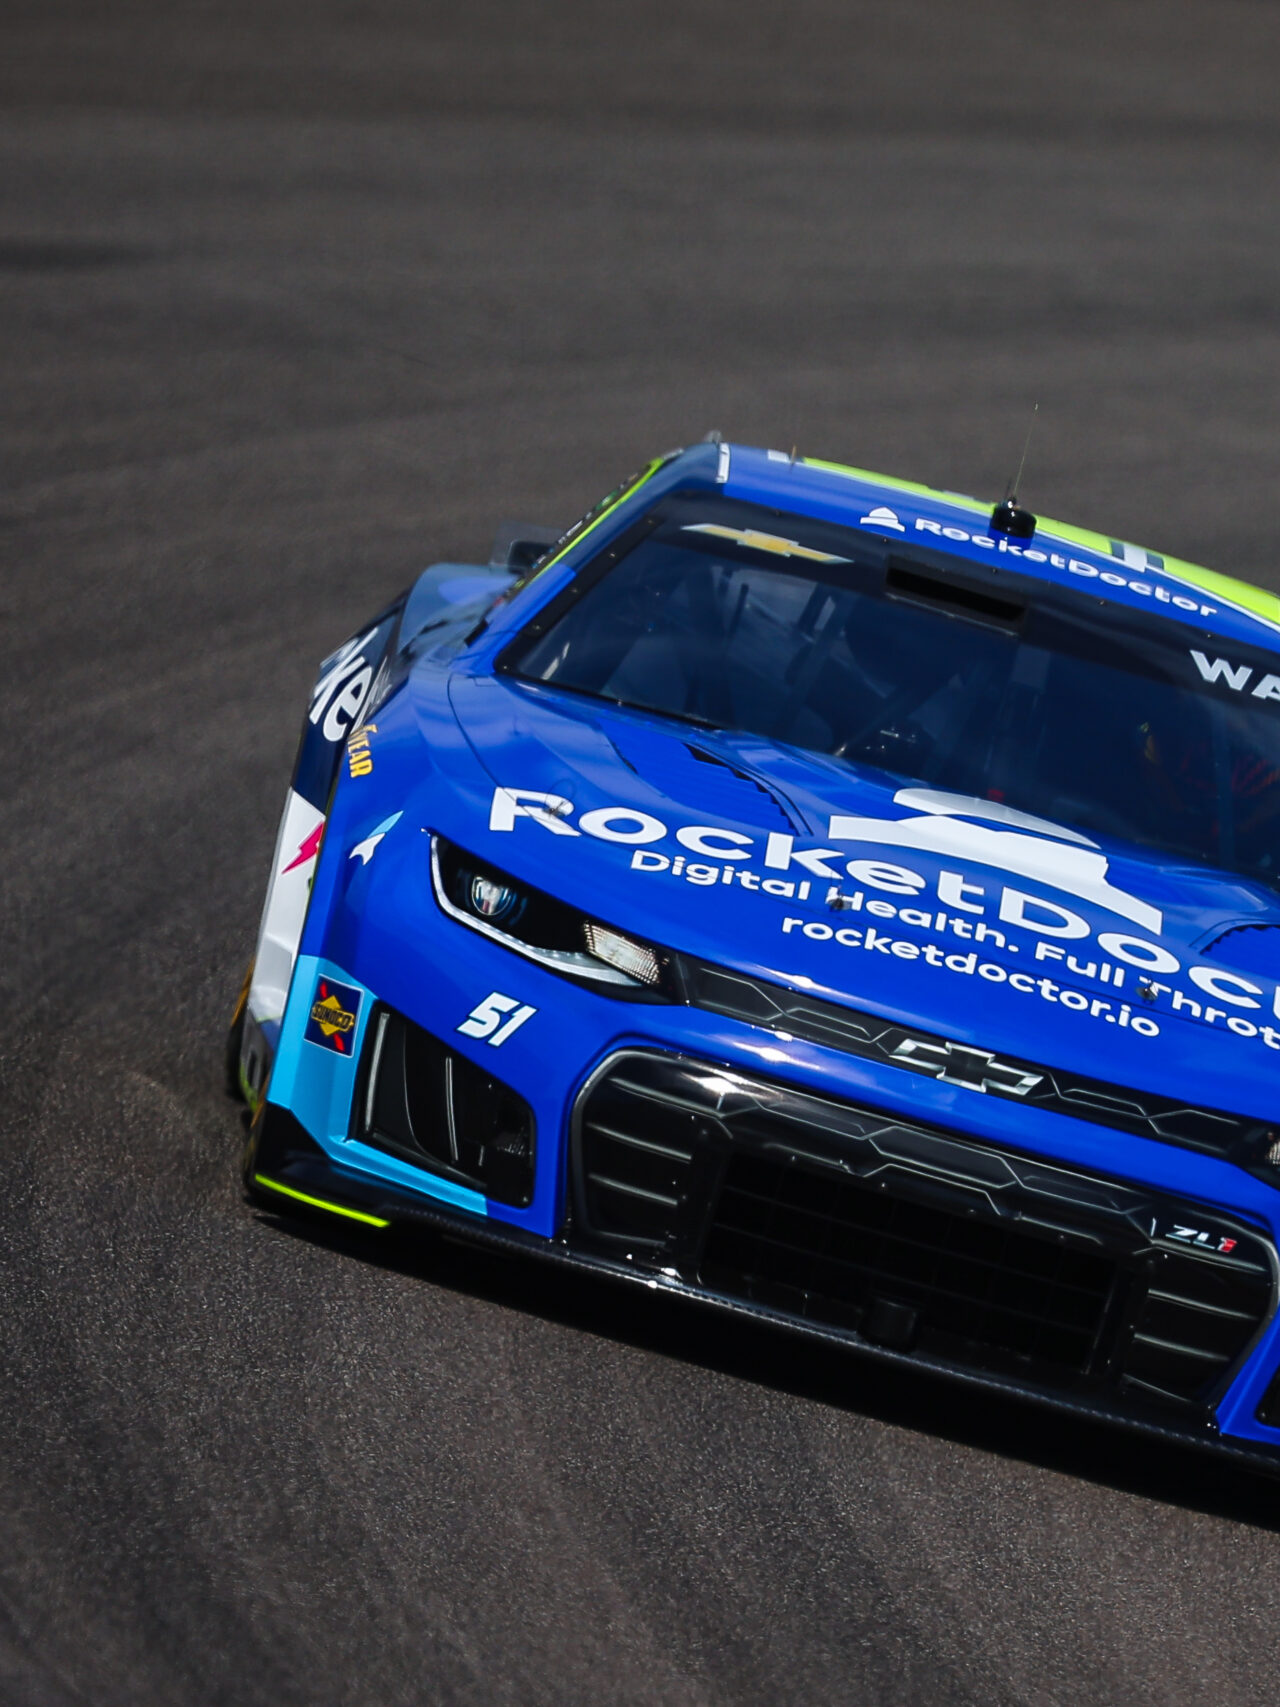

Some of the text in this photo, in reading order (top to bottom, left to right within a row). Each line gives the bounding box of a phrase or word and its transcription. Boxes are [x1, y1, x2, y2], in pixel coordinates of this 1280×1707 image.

[914, 513, 1218, 617] RocketDoctor
[630, 850, 811, 901] Digital
[825, 886, 1019, 953] Health.
[1035, 941, 1125, 988] Full
[456, 991, 538, 1047] 51
[782, 916, 1161, 1037] rocketdoctor.io
